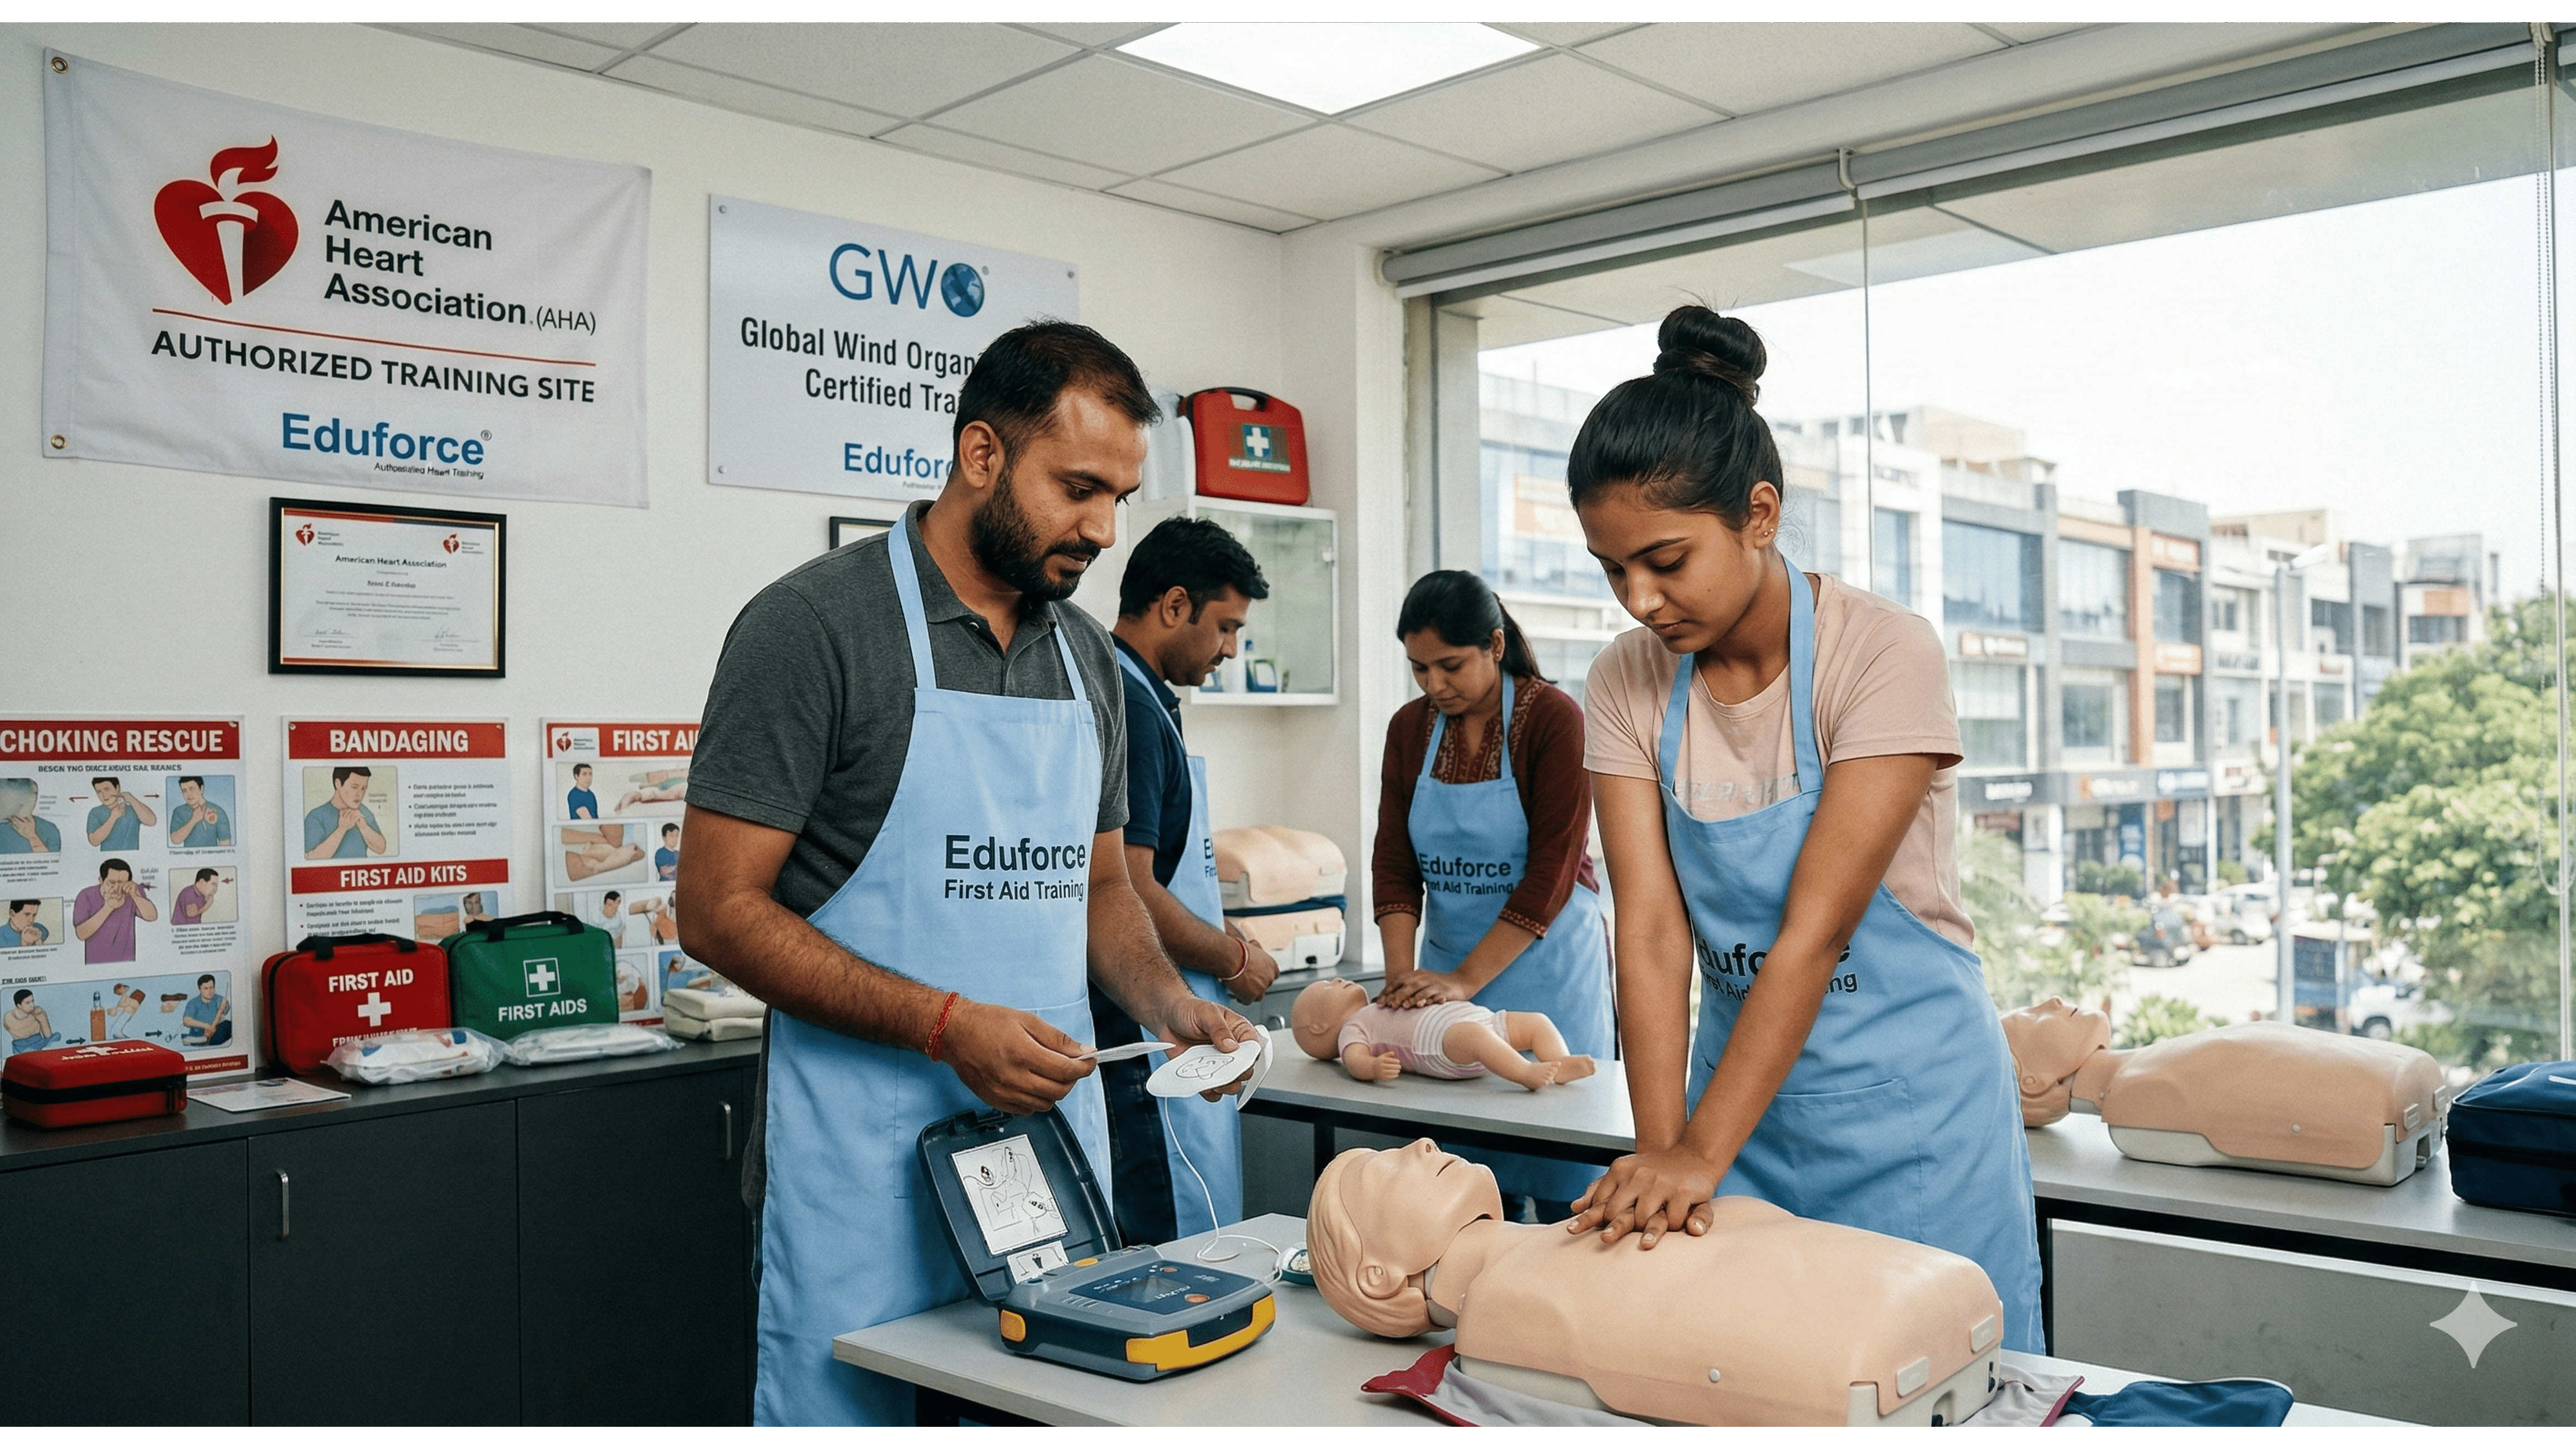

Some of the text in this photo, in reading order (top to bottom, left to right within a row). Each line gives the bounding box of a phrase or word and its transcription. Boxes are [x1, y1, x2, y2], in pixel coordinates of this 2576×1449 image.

[325, 199, 492, 251] American
[325, 235, 424, 276] Heart
[740, 317, 824, 356] Global
[834, 330, 896, 366] Wind
[151, 330, 595, 403] AUTHORIZED TRAINING SITE
[805, 369, 911, 409] Certified
[335, 555, 376, 564] American
[377, 557, 400, 566] Heart
[0, 729, 223, 753] CHOKING RESCUE
[330, 729, 469, 753] BANDAGING
[613, 729, 671, 751] FIRST
[945, 835, 1086, 871] Eduforce
[1419, 853, 1511, 877] Eduforce
[340, 865, 468, 887] FIRST AID KITS
[1443, 881, 1461, 893] Aid
[1464, 882, 1513, 895] Training
[945, 879, 1084, 902] First Aid Training
[329, 968, 414, 993] FIRST AID
[498, 998, 588, 1022] FIRST AIDS
